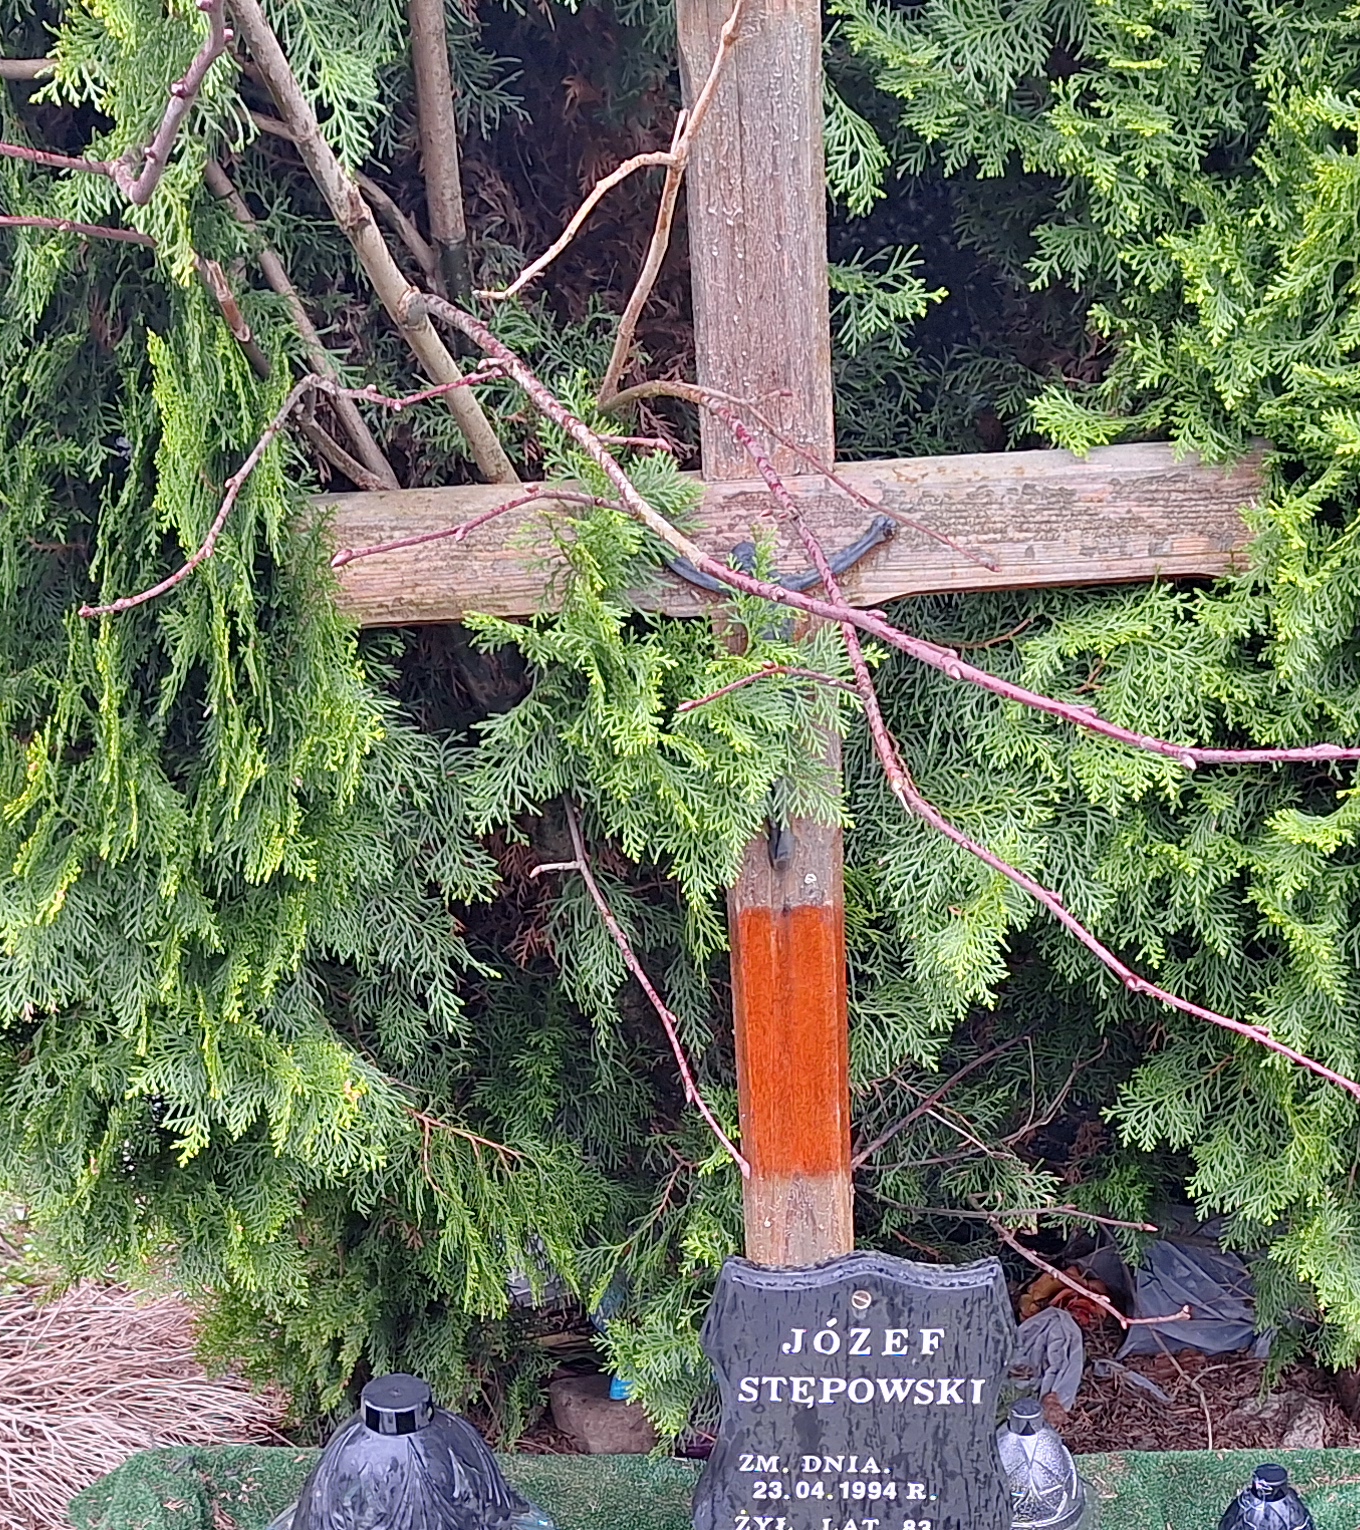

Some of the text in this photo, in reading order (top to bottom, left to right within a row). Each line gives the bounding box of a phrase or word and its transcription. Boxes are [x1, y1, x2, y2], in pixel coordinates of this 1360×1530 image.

[782, 1318, 945, 1356] JÓZEF
[738, 1376, 986, 1408] STĘPOWSKI
[739, 1455, 891, 1474] ZM. DNIA.
[906, 1484, 937, 1500] R.
